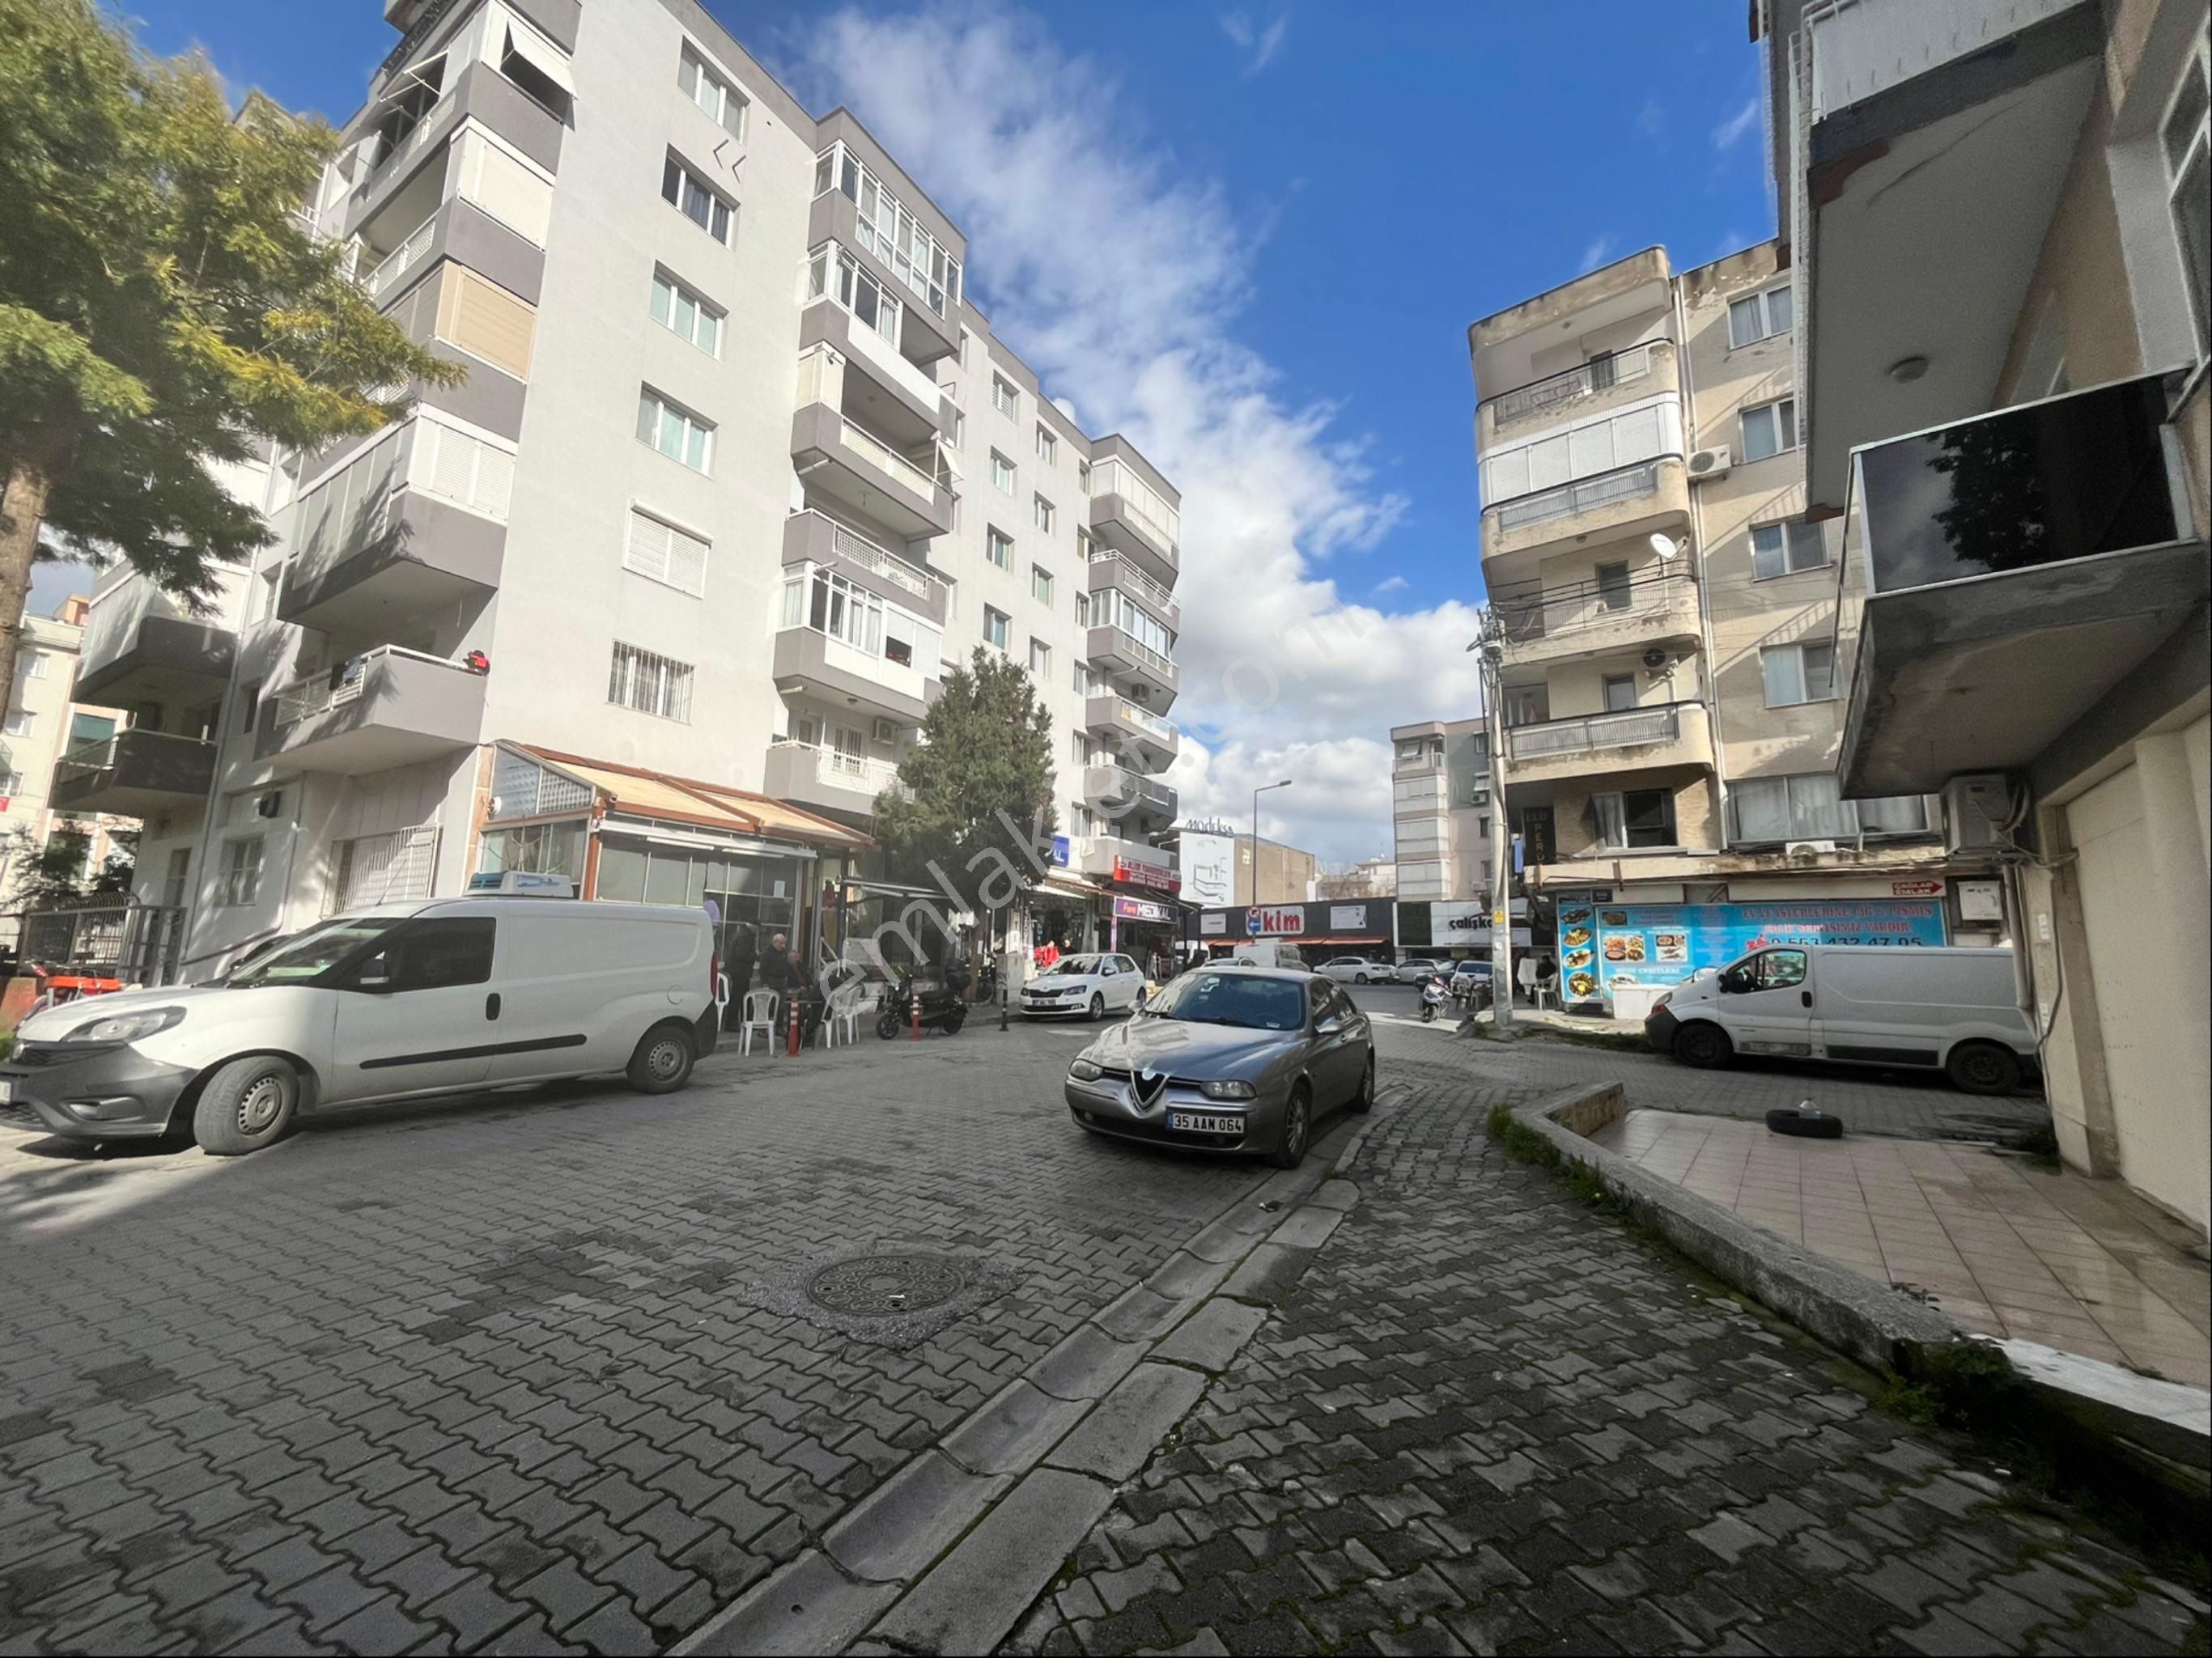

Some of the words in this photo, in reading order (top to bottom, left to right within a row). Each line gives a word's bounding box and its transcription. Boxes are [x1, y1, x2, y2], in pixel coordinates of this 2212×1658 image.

[1263, 910, 1301, 932] kim
[1174, 1115, 1189, 1128] 35
[1193, 1117, 1215, 1130] AAN
[1219, 1118, 1242, 1131] 064
